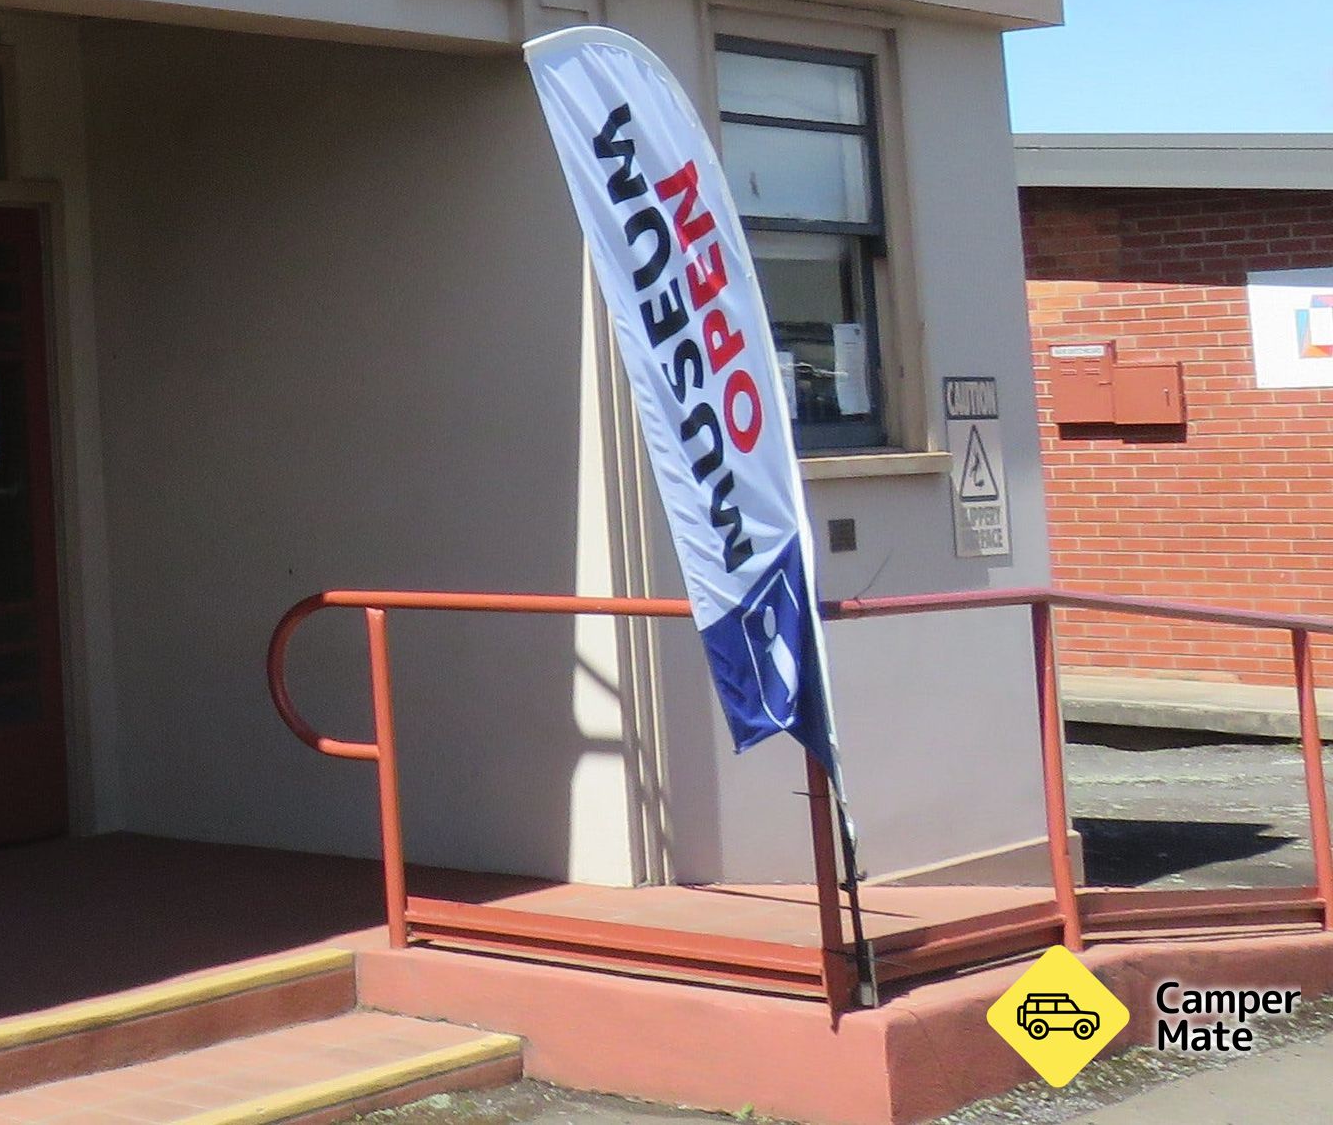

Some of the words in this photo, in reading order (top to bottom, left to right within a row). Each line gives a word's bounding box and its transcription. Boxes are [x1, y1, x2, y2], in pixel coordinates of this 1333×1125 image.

[592, 102, 754, 575] MUSEUM
[654, 158, 764, 455] OPEN
[945, 380, 998, 417] CAUTION
